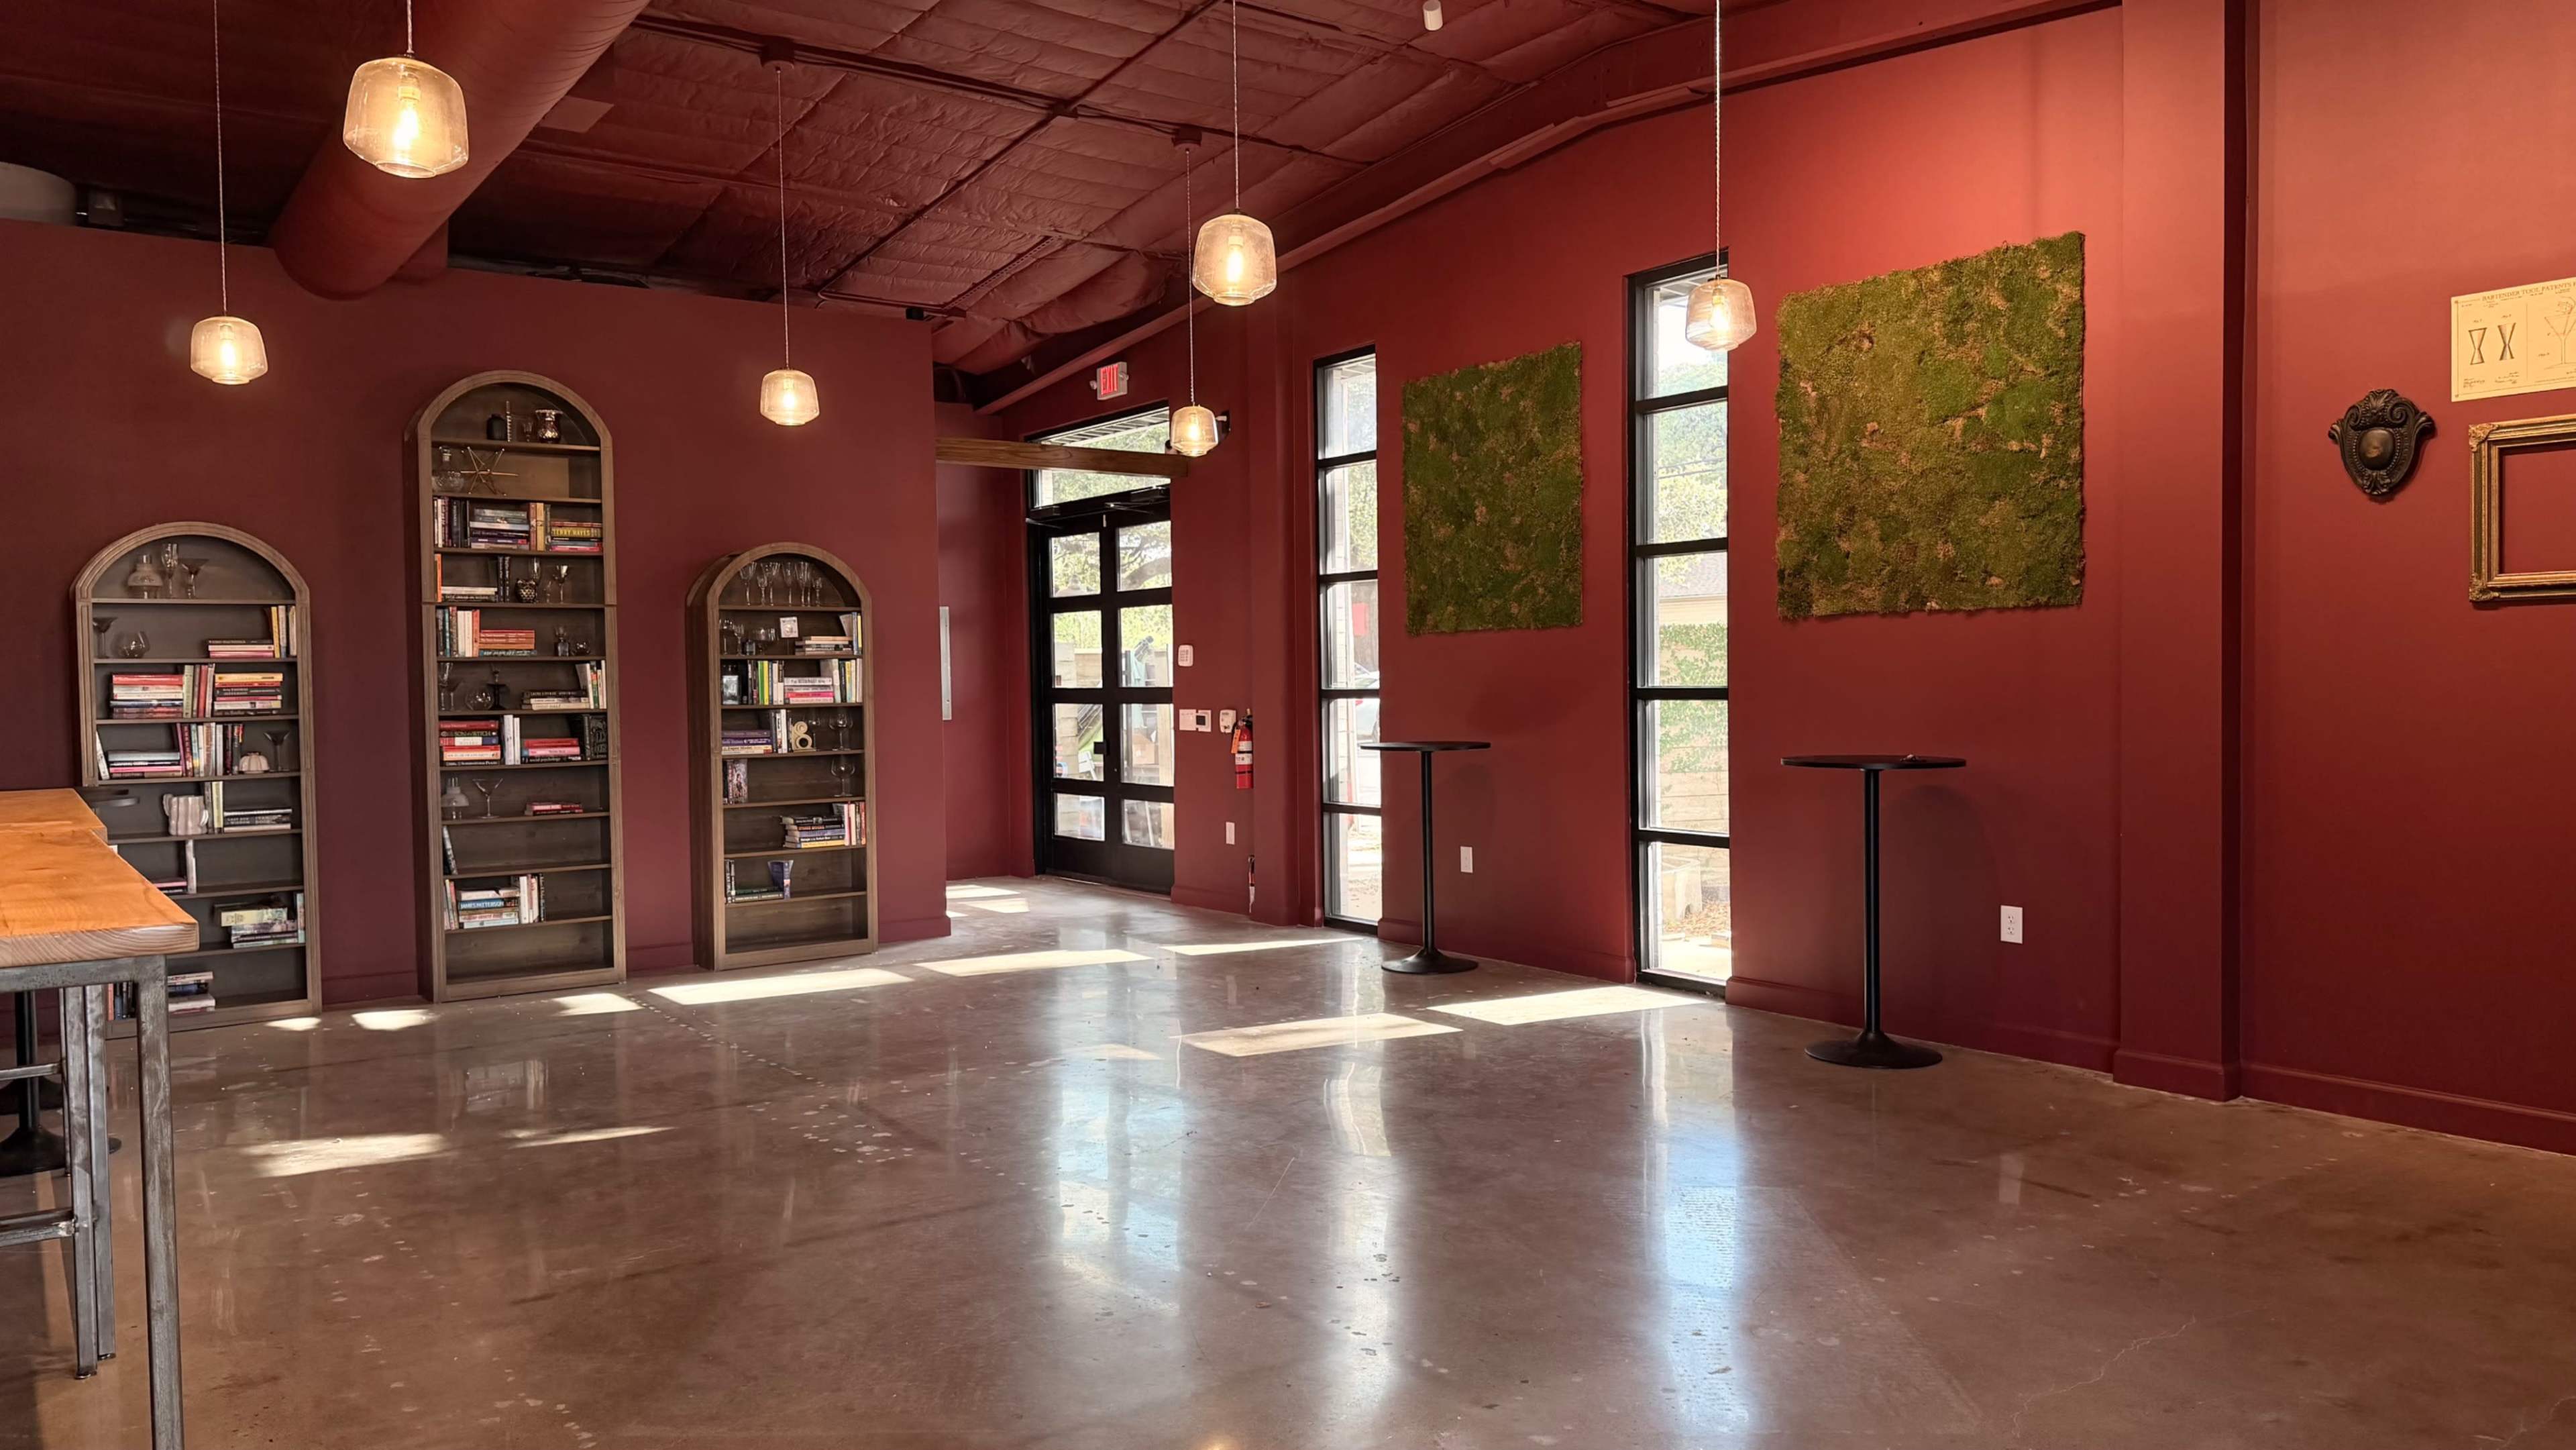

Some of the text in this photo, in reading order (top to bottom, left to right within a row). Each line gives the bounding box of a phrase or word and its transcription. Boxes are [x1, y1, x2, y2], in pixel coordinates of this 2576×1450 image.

[2482, 291, 2521, 301] BARTENDER
[2522, 287, 2540, 295] TOOL
[2541, 281, 2572, 292] PATENTS
[1100, 364, 1118, 395] EXIT
